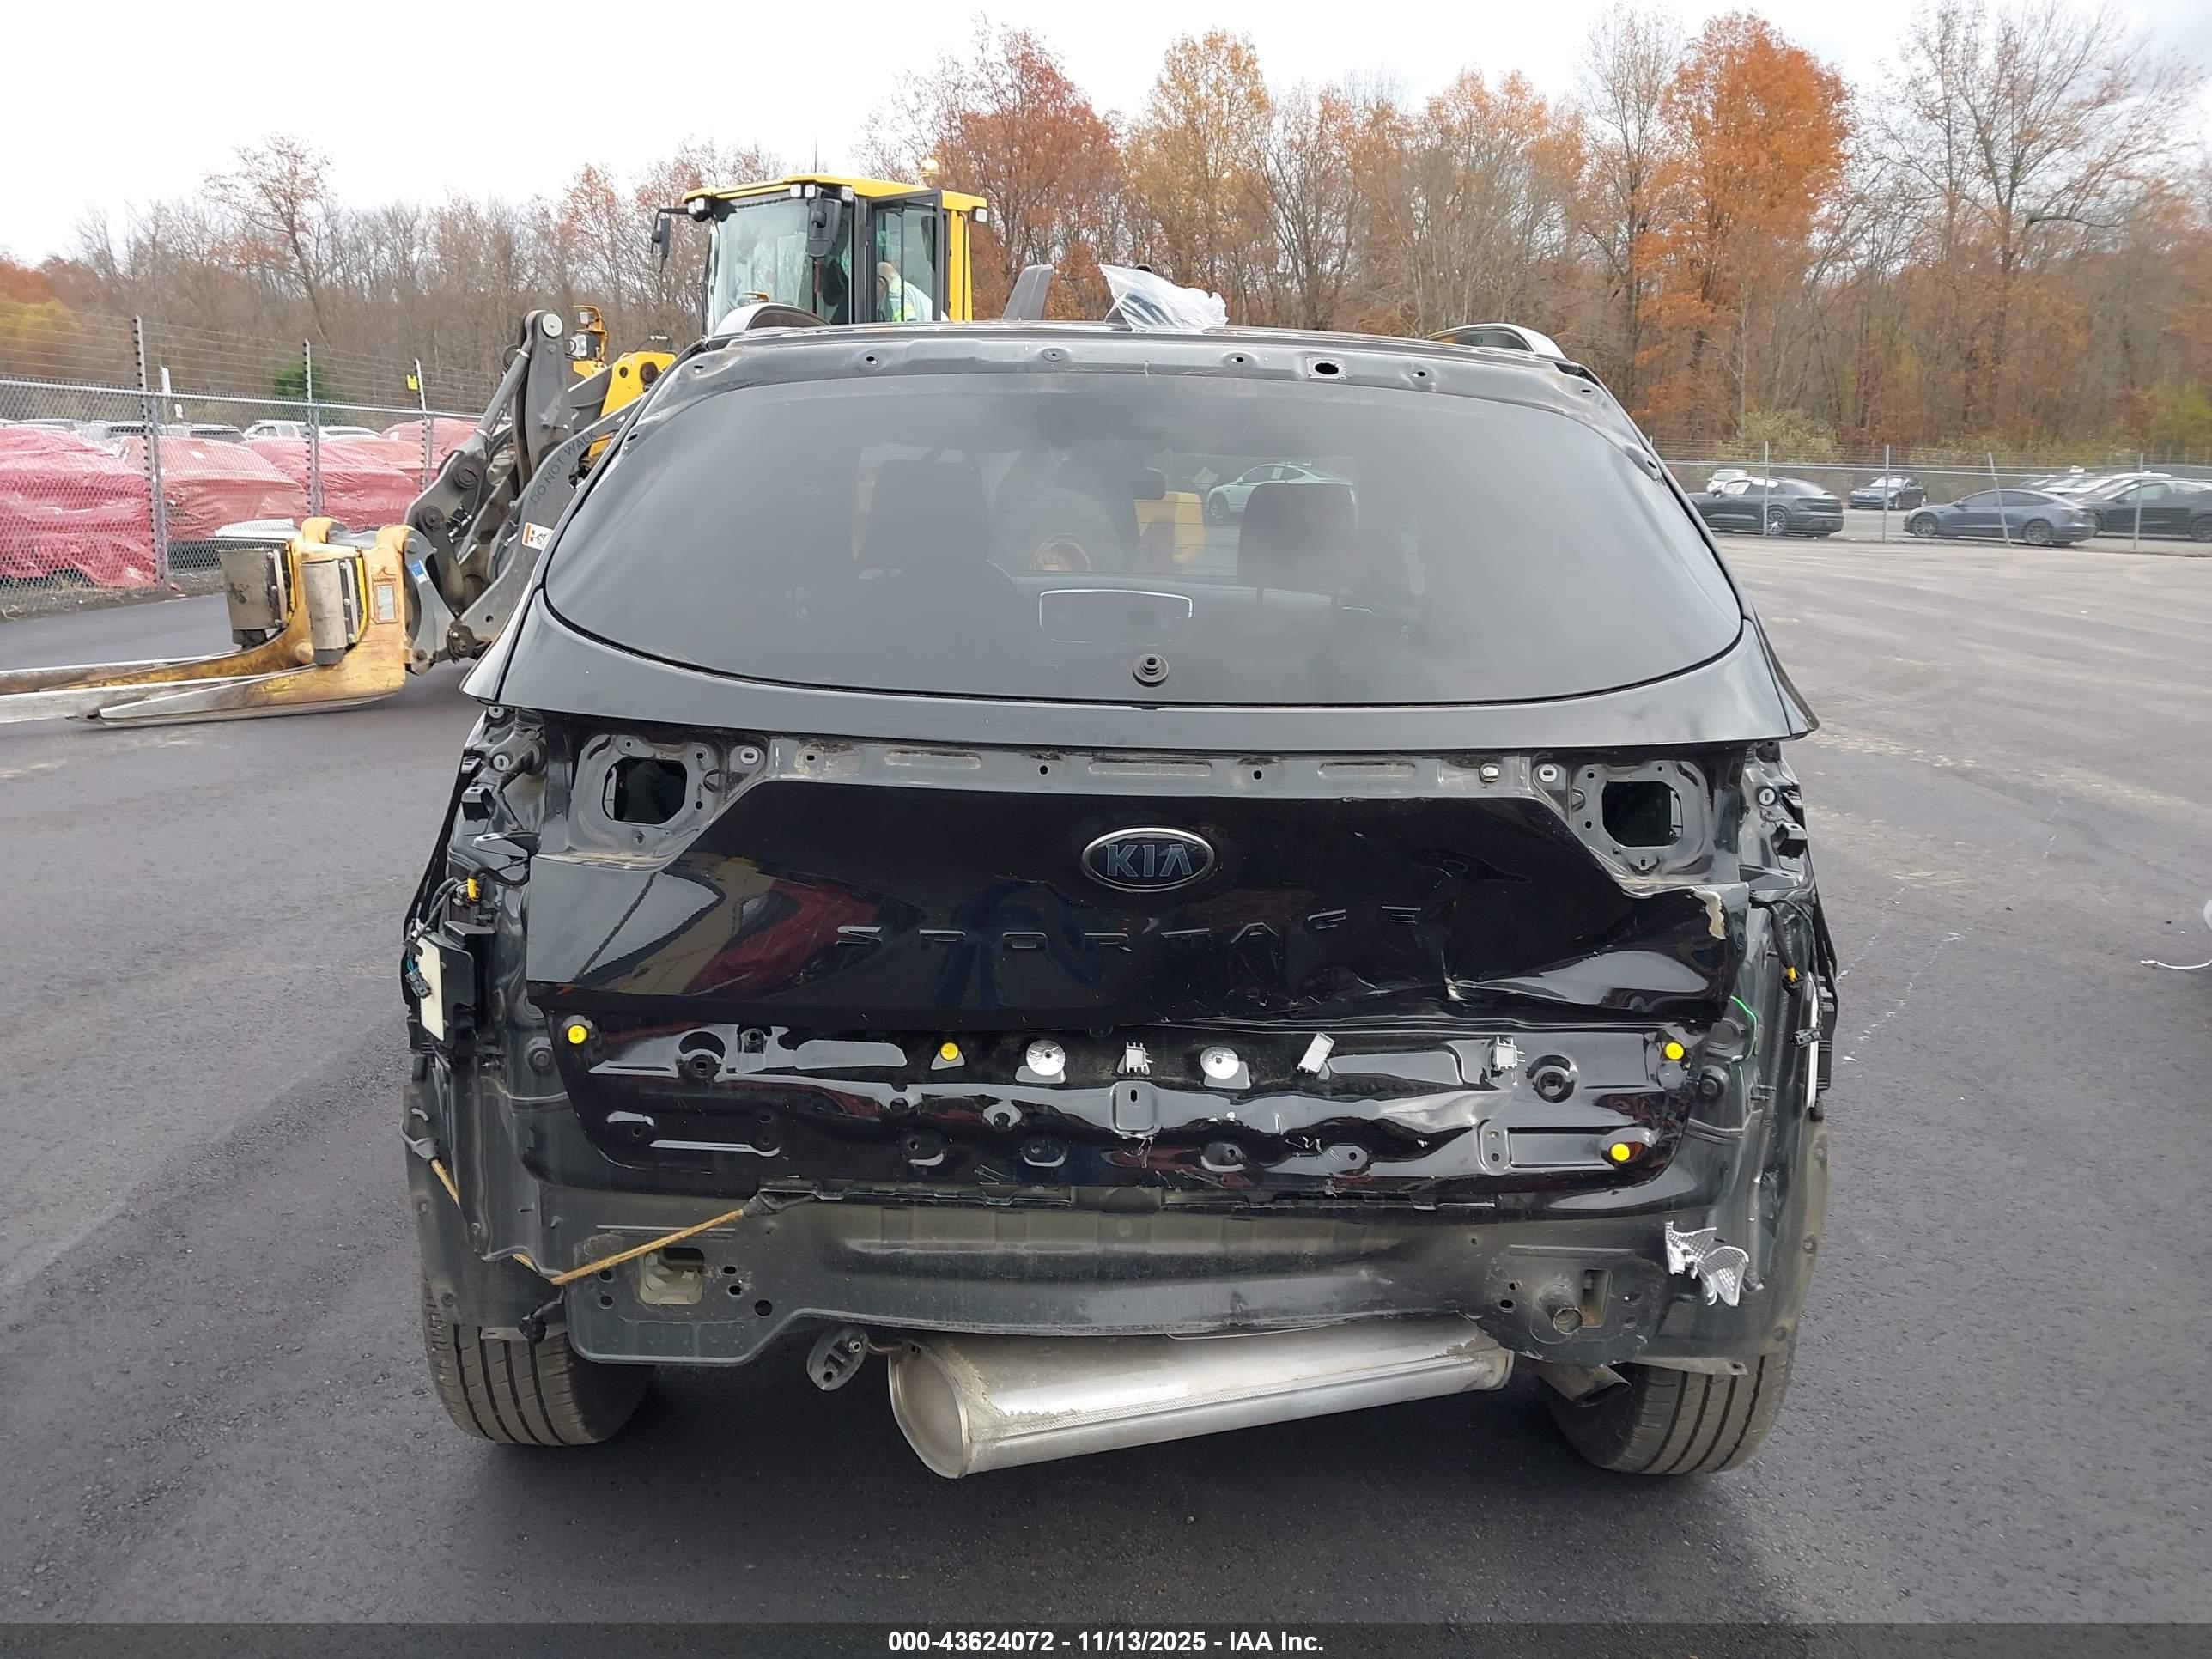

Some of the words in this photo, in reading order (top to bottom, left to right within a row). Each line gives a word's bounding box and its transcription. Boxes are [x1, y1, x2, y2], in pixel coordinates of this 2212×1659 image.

[529, 484, 547, 505] DO
[544, 456, 567, 485] NOT
[563, 431, 597, 456] WALK
[1105, 844, 1193, 877] KIA
[836, 906, 1422, 952] SPORTAGE
